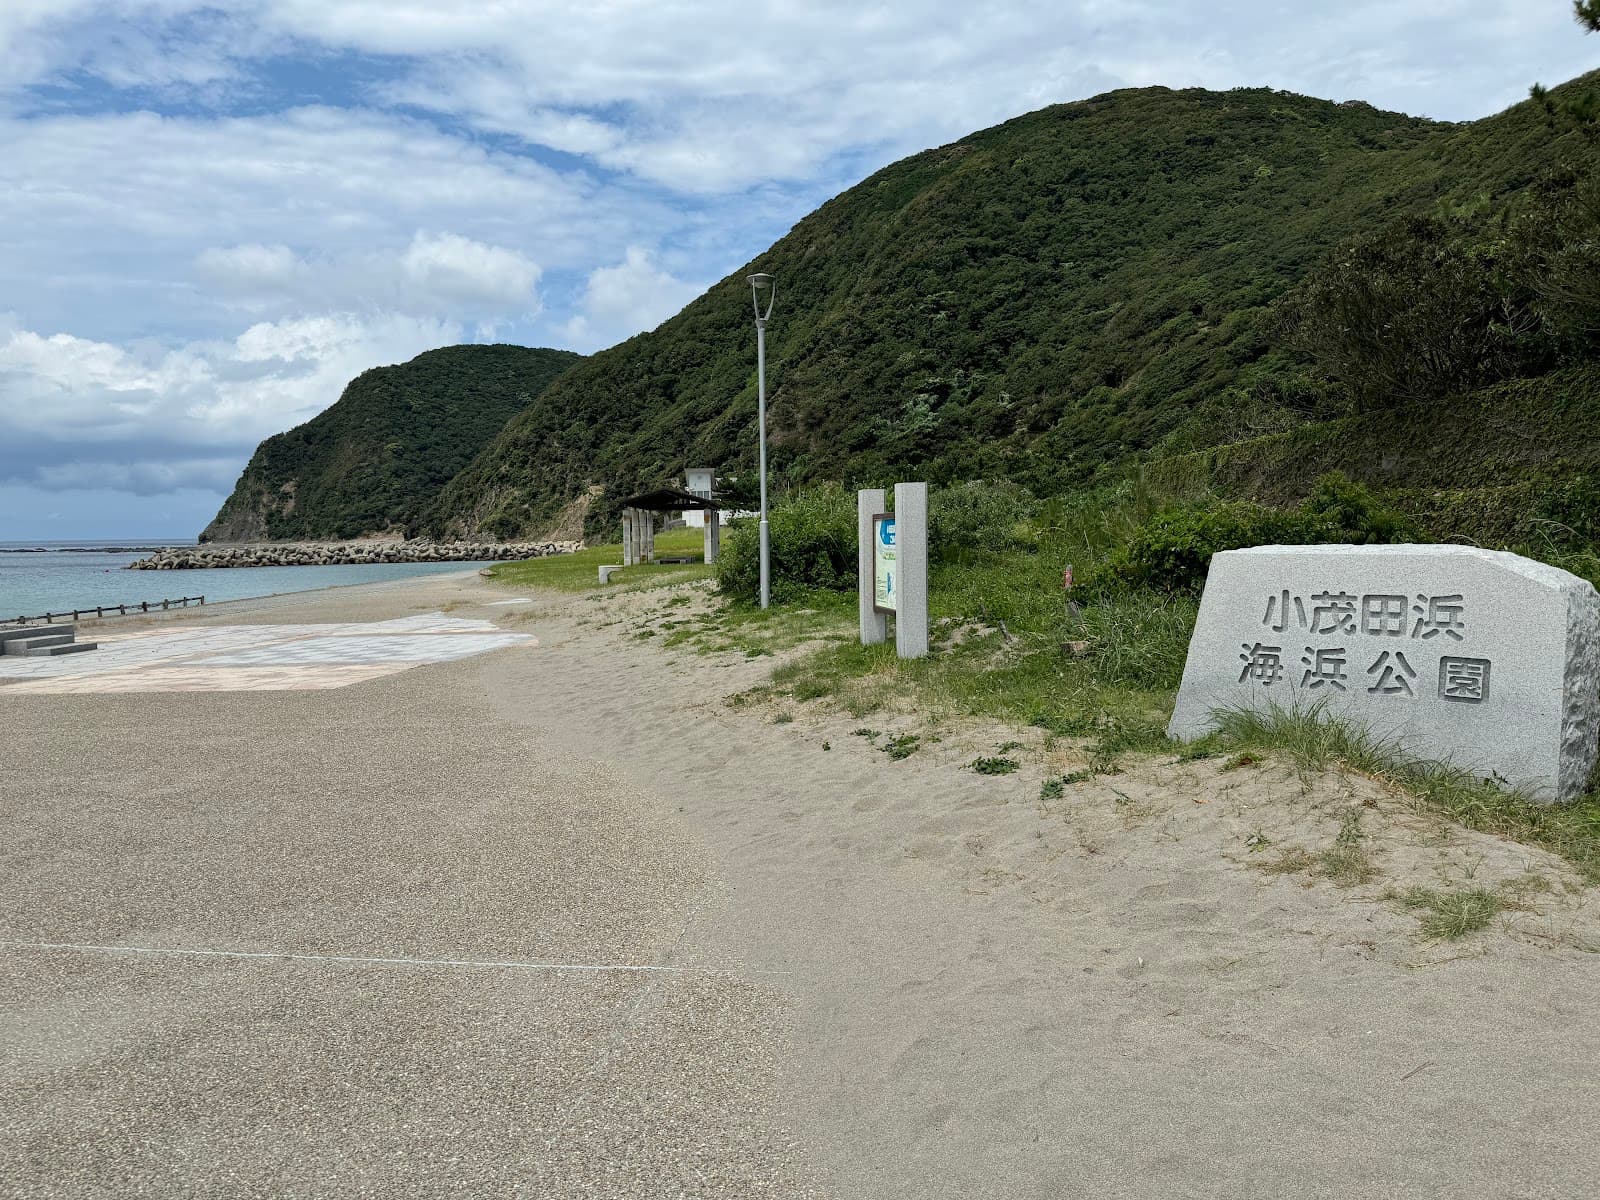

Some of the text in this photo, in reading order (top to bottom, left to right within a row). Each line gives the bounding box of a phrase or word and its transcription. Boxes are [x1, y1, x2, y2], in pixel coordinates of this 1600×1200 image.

[1262, 589, 1465, 641] 小茂田浜
[1238, 642, 1491, 704] 海浜公園
